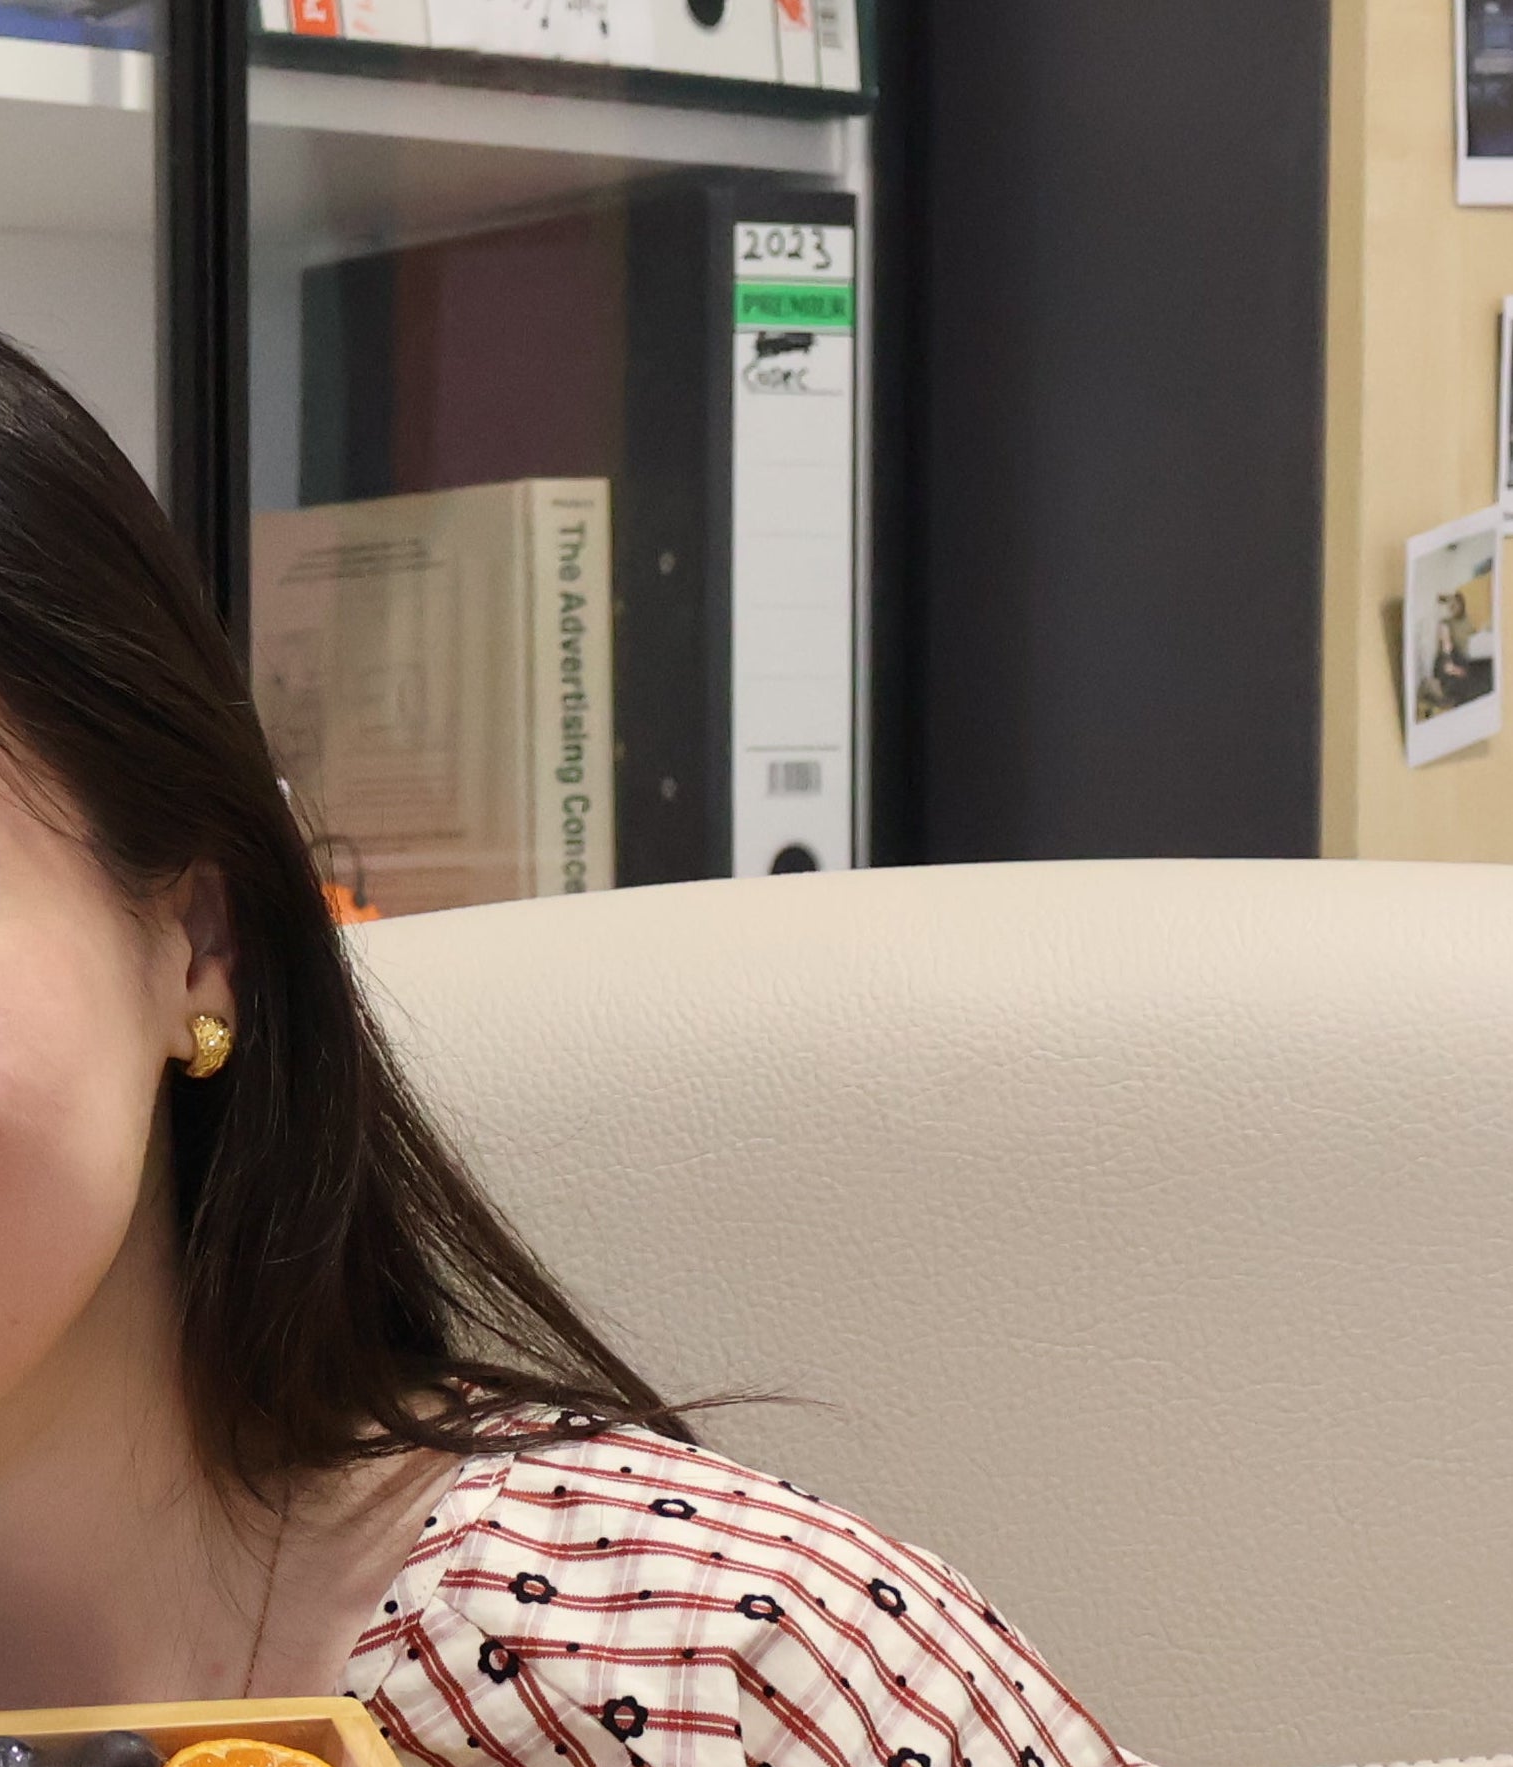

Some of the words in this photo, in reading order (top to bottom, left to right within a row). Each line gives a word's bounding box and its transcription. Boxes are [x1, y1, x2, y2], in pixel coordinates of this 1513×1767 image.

[743, 225, 832, 270] 2023
[559, 521, 586, 583] The
[554, 592, 589, 787] Advertising
